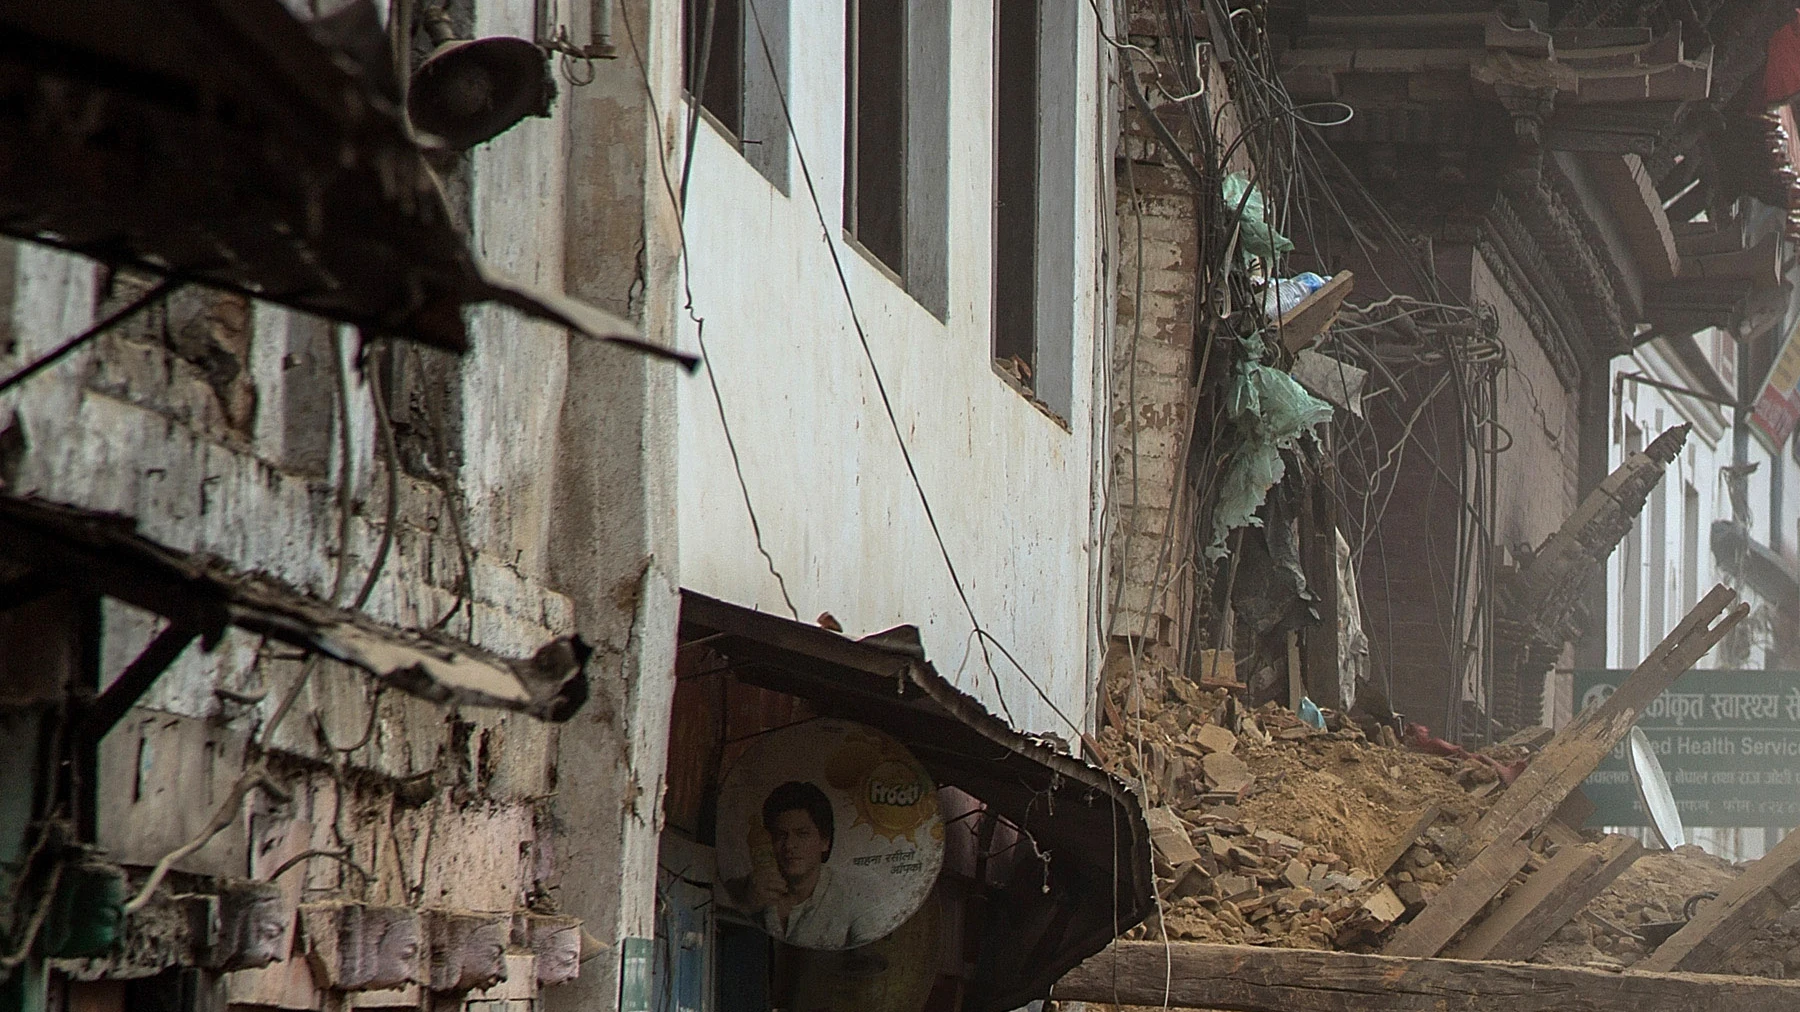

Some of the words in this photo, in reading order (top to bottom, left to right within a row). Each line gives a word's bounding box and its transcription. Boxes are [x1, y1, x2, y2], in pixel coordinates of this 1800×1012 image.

[1640, 689, 1704, 725] कीकृत
[1710, 694, 1780, 720] स्वास्थ्य
[1677, 737, 1735, 755] Health
[871, 781, 919, 805] Frooti
